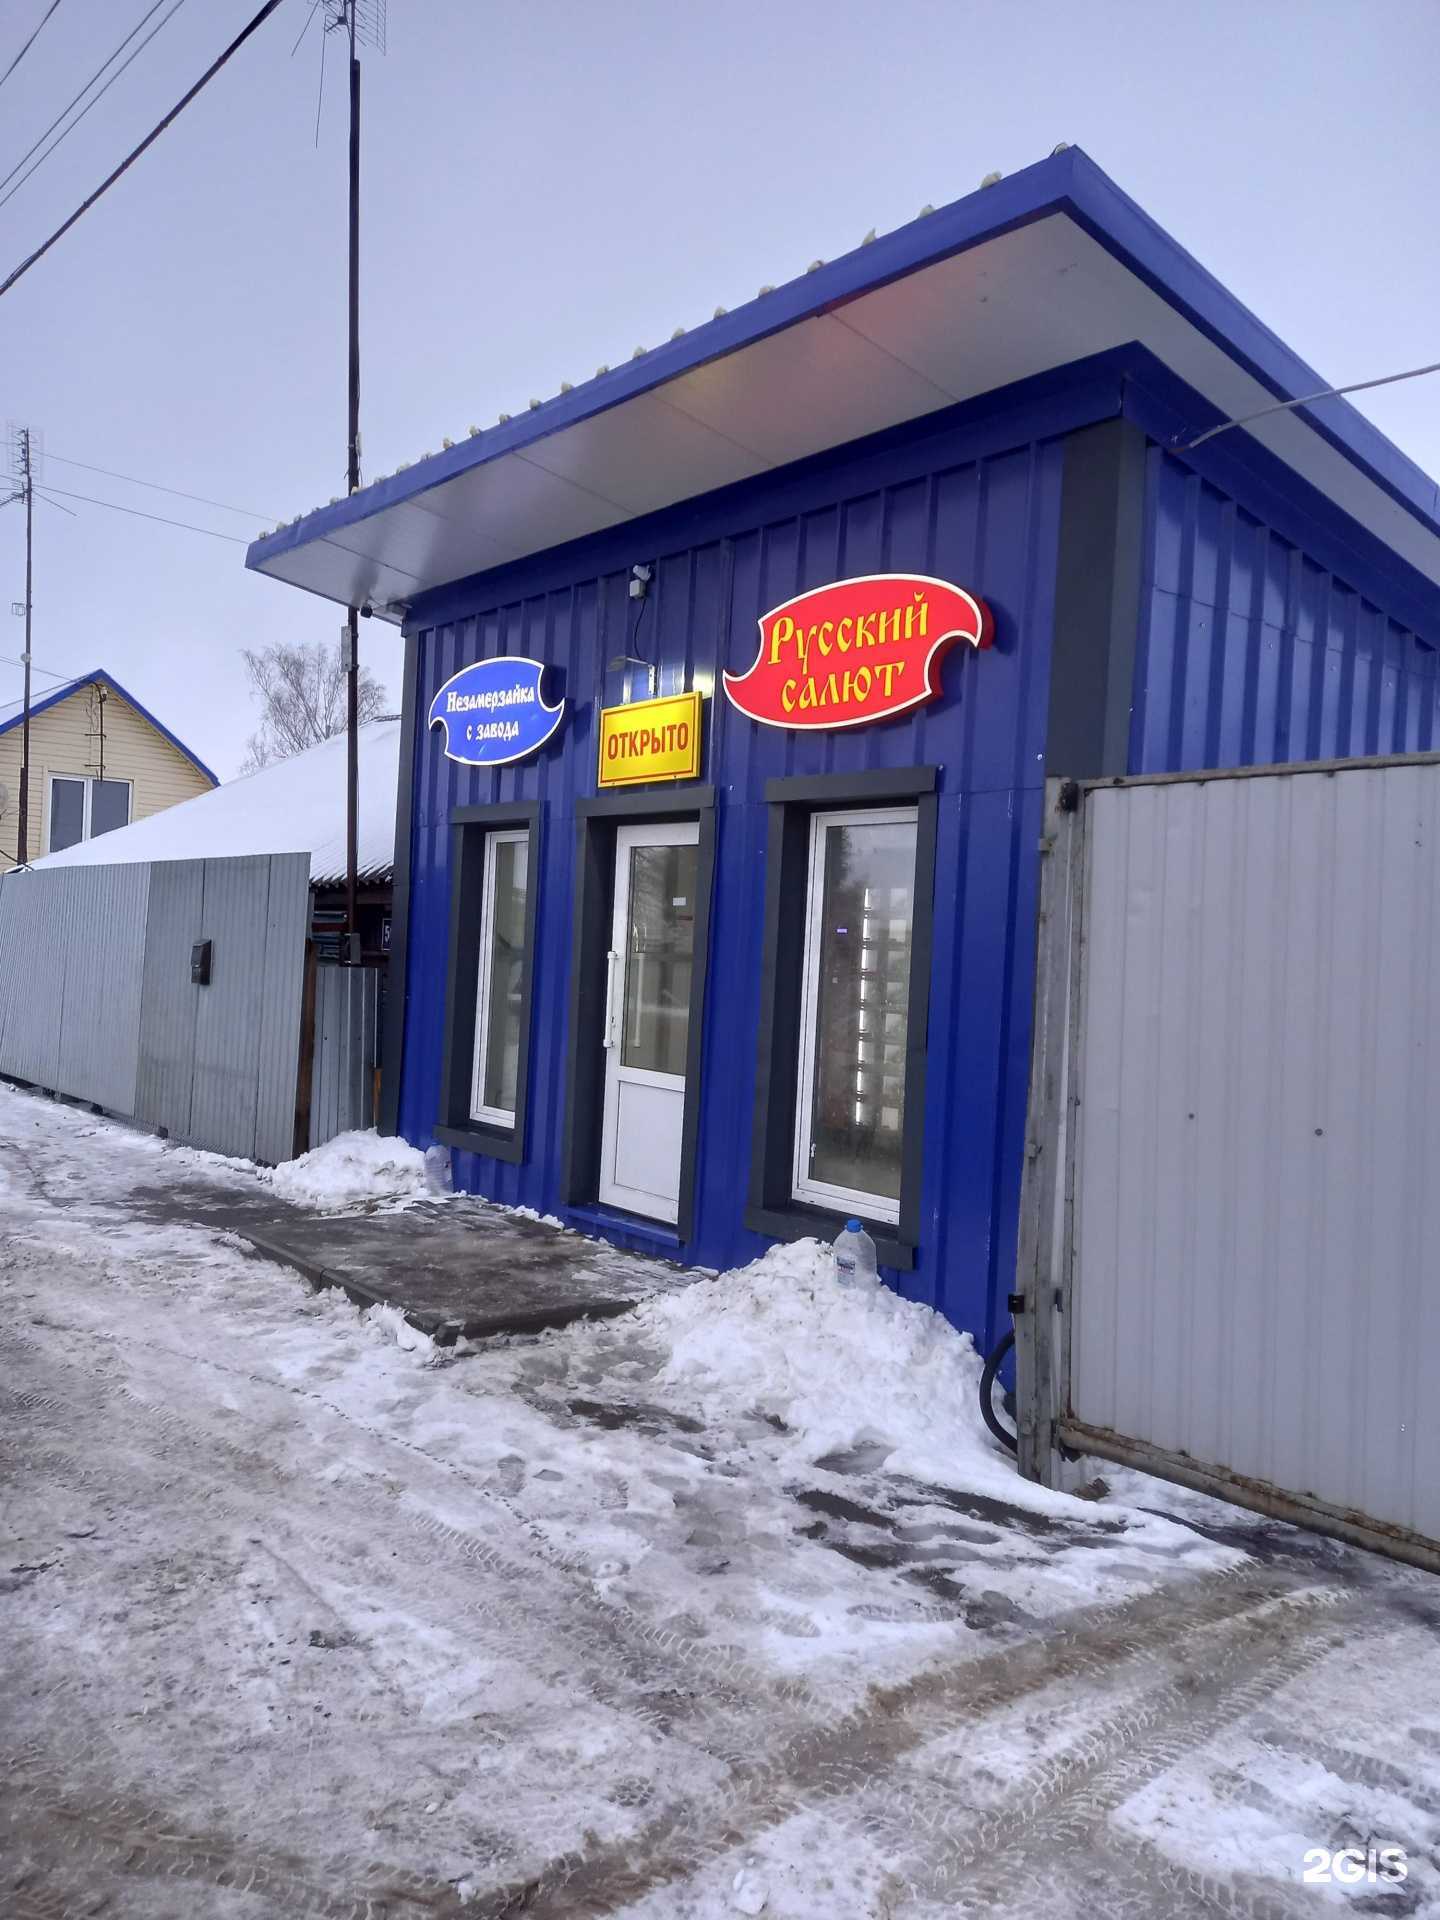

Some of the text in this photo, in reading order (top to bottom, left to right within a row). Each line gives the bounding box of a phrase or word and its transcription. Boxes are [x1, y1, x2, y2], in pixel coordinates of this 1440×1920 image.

[767, 591, 929, 675] Русский
[446, 683, 535, 713] Незамерзайка
[607, 722, 689, 760] ОТКРЫТО
